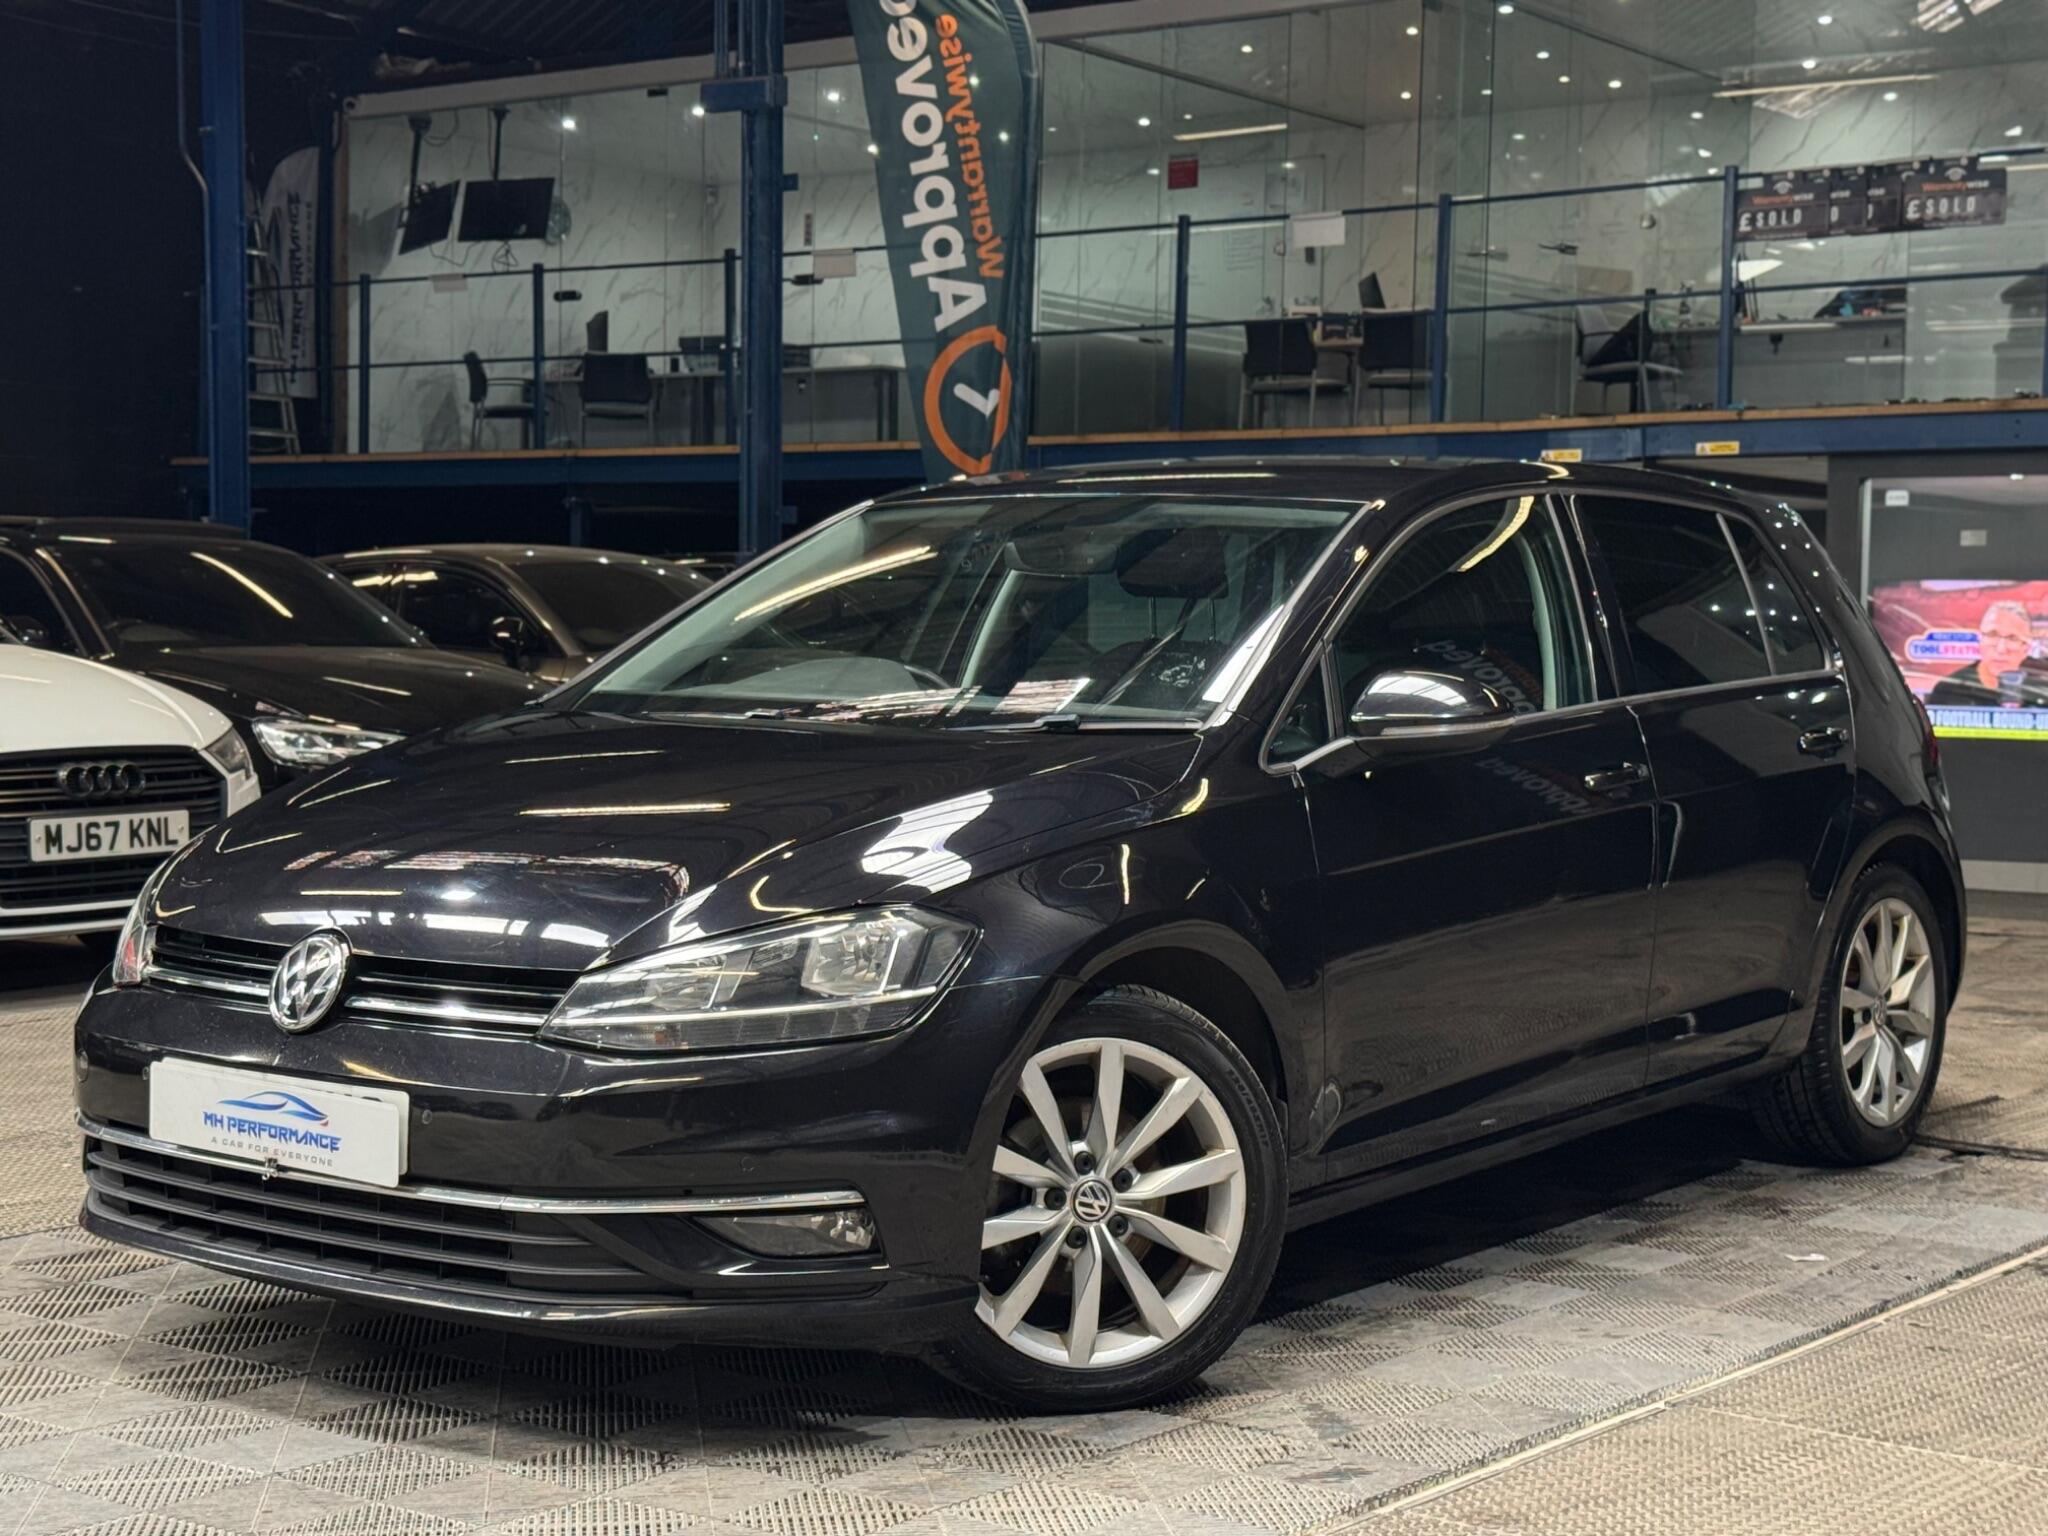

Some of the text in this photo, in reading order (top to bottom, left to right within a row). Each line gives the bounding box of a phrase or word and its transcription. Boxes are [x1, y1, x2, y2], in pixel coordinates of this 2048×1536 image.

[44, 817, 179, 854] MJ67 KNL
[202, 1111, 342, 1153] MH PERFORMANCE
[211, 1136, 334, 1167] A CAR FOR EVERYONE
